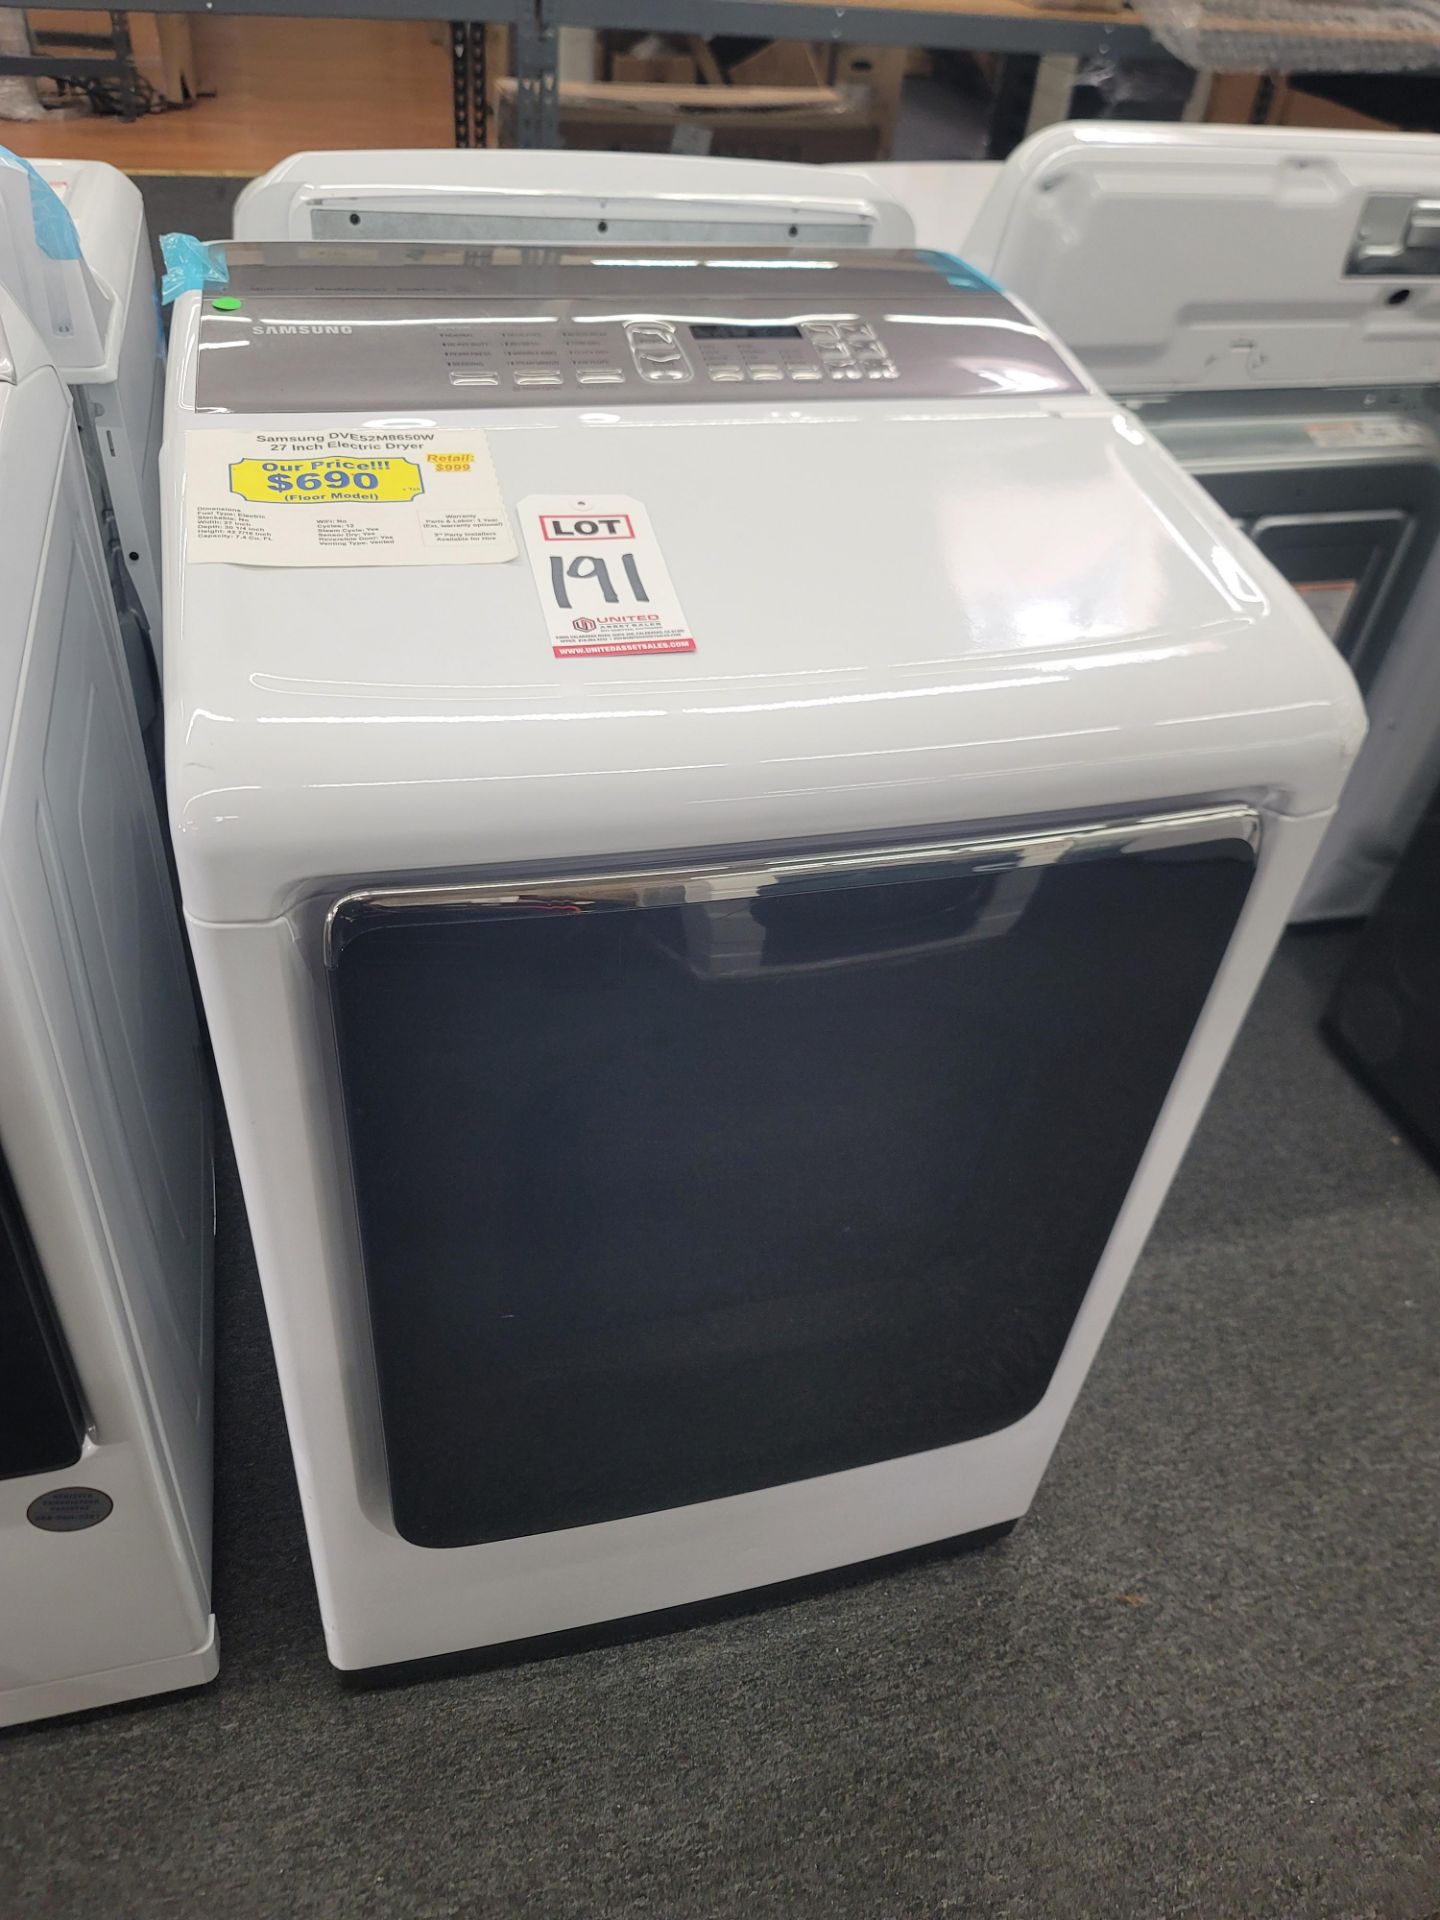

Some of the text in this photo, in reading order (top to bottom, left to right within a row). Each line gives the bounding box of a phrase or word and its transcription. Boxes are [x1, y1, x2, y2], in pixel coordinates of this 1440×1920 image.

[252, 326, 352, 335] SAMSUNG
[256, 432, 434, 443] Samsung DVE52M8650W
[292, 443, 324, 451] Inch
[328, 441, 384, 450] Electric
[386, 442, 424, 450] Dryer
[426, 454, 475, 463] Retail:
[262, 459, 390, 472] Our Price!!!
[435, 464, 471, 472] $999
[266, 470, 379, 493] $690
[284, 492, 379, 502] (Floor Model)
[552, 519, 621, 536] LOT
[550, 553, 650, 609] 191
[596, 614, 660, 624] UNITED
[560, 641, 689, 655] WWW.UNITEDASSETSALES.COM
